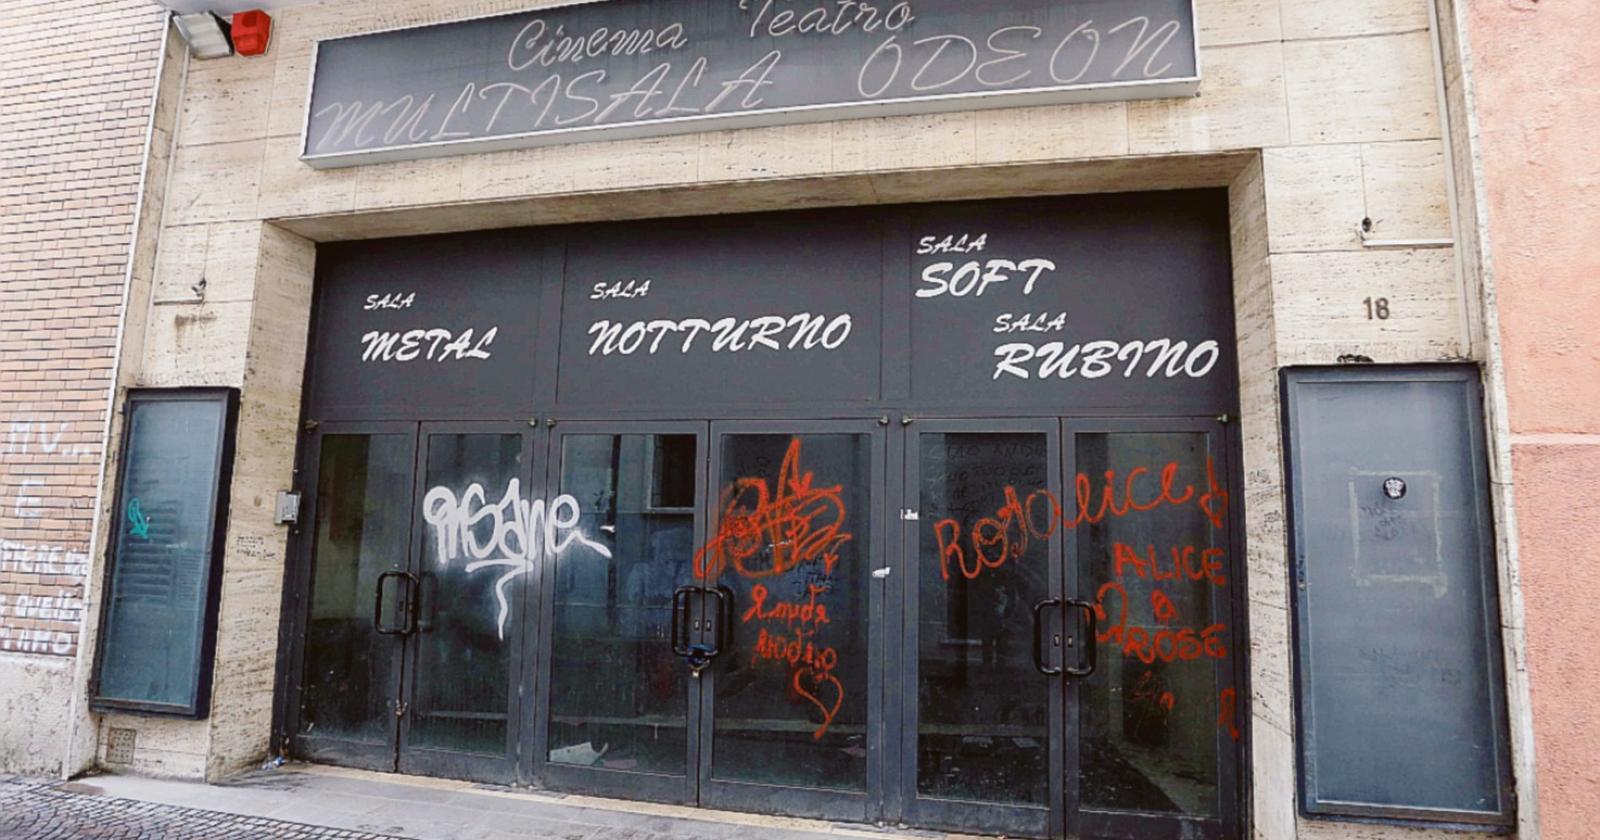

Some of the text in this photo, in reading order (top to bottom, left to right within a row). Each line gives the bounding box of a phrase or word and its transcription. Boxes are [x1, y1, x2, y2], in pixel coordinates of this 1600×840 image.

[508, 0, 915, 72] Cinema Teatro
[315, 16, 1180, 151] MULTISALA ODEON
[917, 233, 987, 254] SALA
[591, 279, 651, 299] SALA
[916, 258, 1056, 298] SOFT
[364, 292, 416, 310] SALA
[1364, 297, 1390, 320] 18
[589, 312, 852, 356] NOTTURNO
[994, 311, 1067, 333] SALA
[362, 326, 498, 362] METAL
[993, 338, 1219, 380] RUBINO
[1115, 542, 1225, 584] ALICE
[1123, 623, 1225, 664] ROSE
